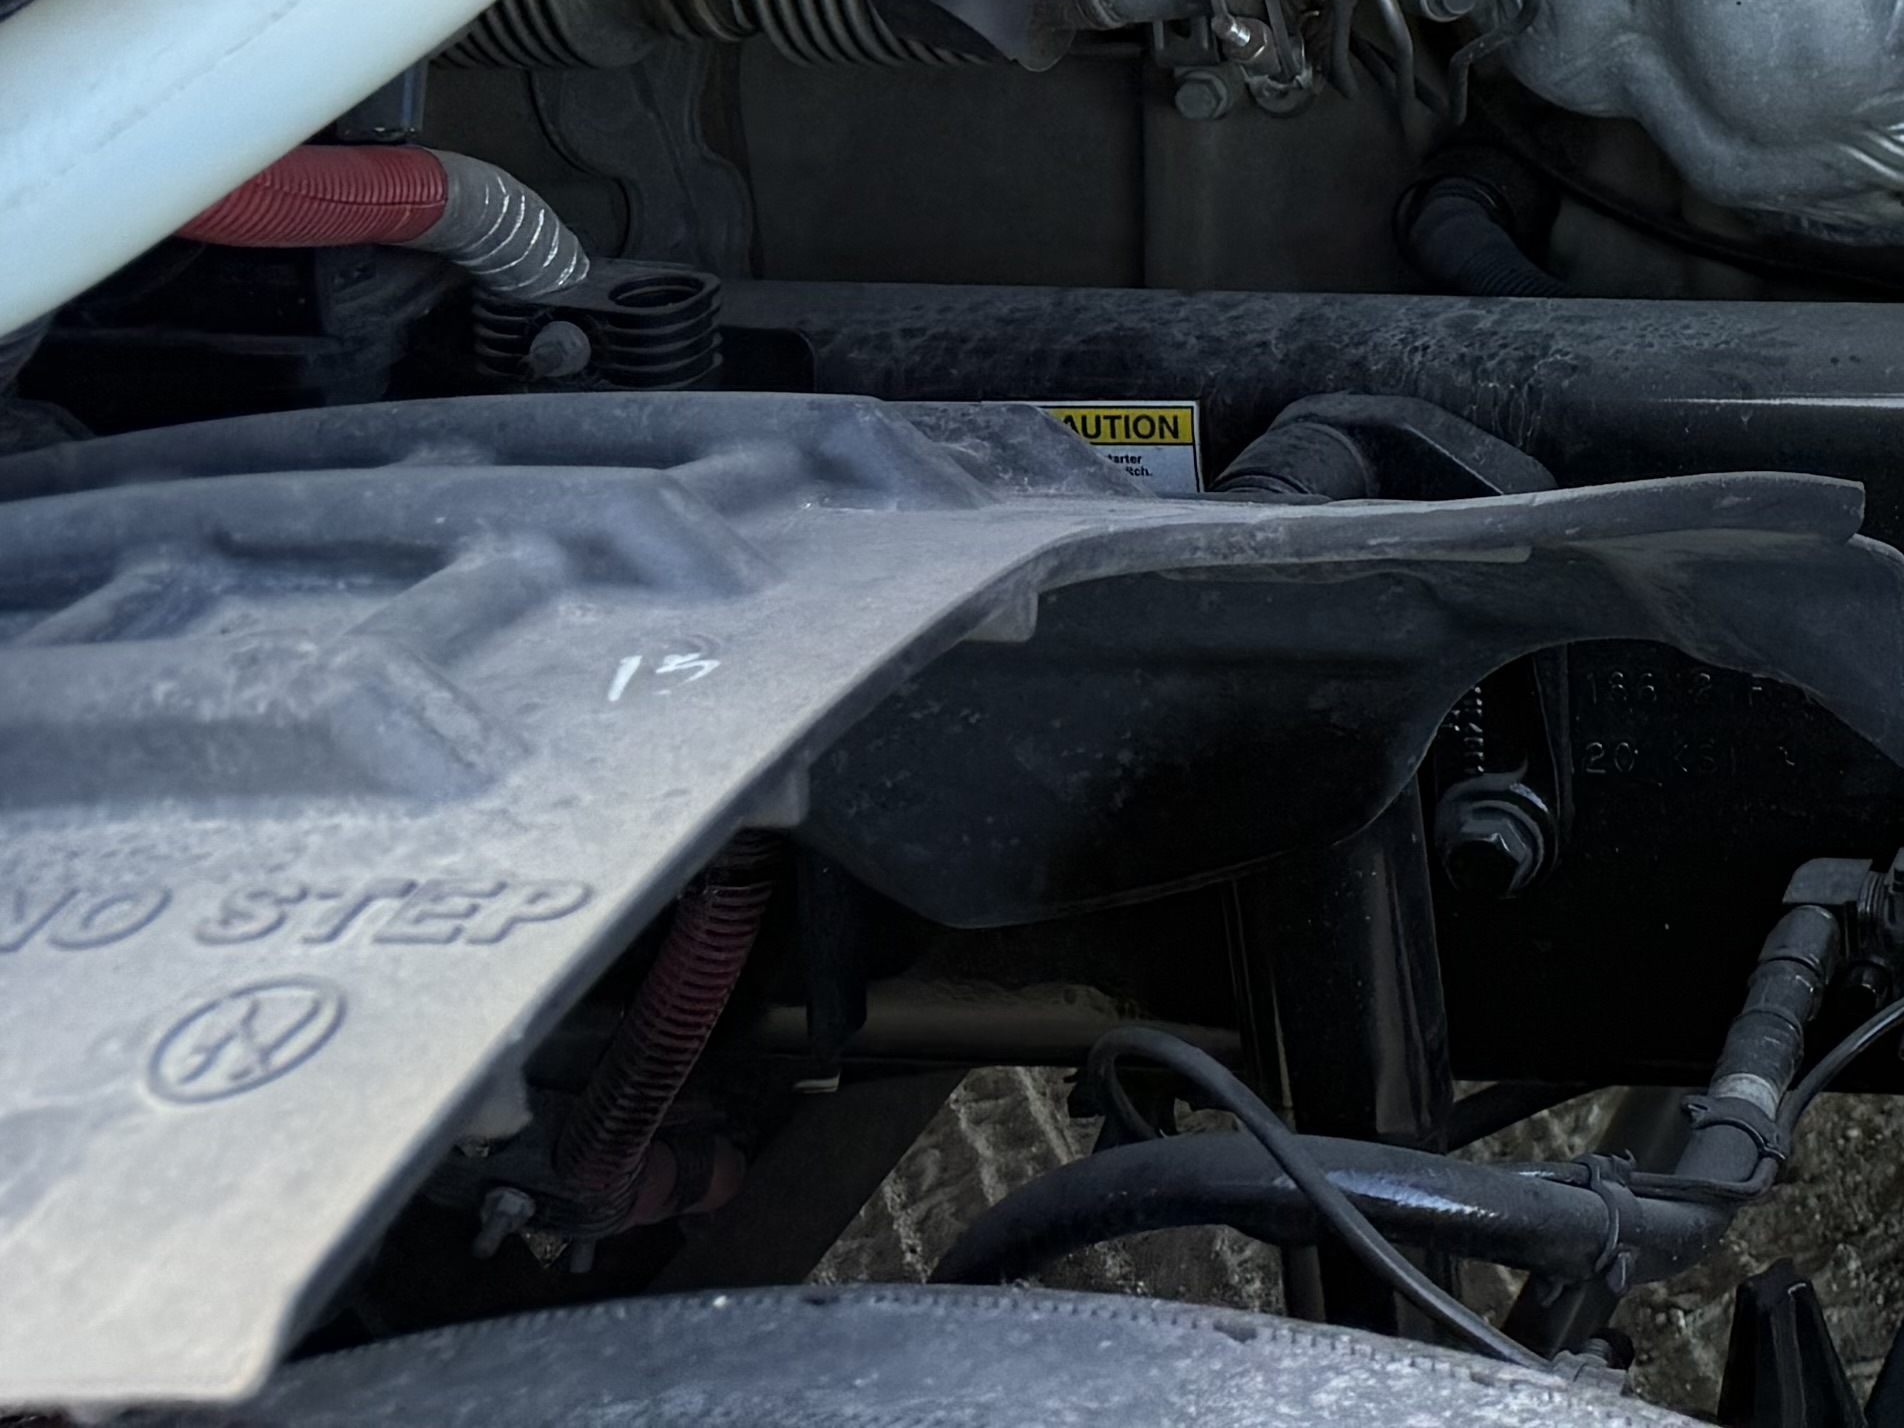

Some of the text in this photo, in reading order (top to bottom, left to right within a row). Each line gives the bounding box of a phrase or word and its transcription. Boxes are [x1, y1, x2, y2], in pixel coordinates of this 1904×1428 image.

[1063, 414, 1180, 440] AUTION
[1108, 453, 1143, 465] tarter
[194, 877, 595, 947] STEP
